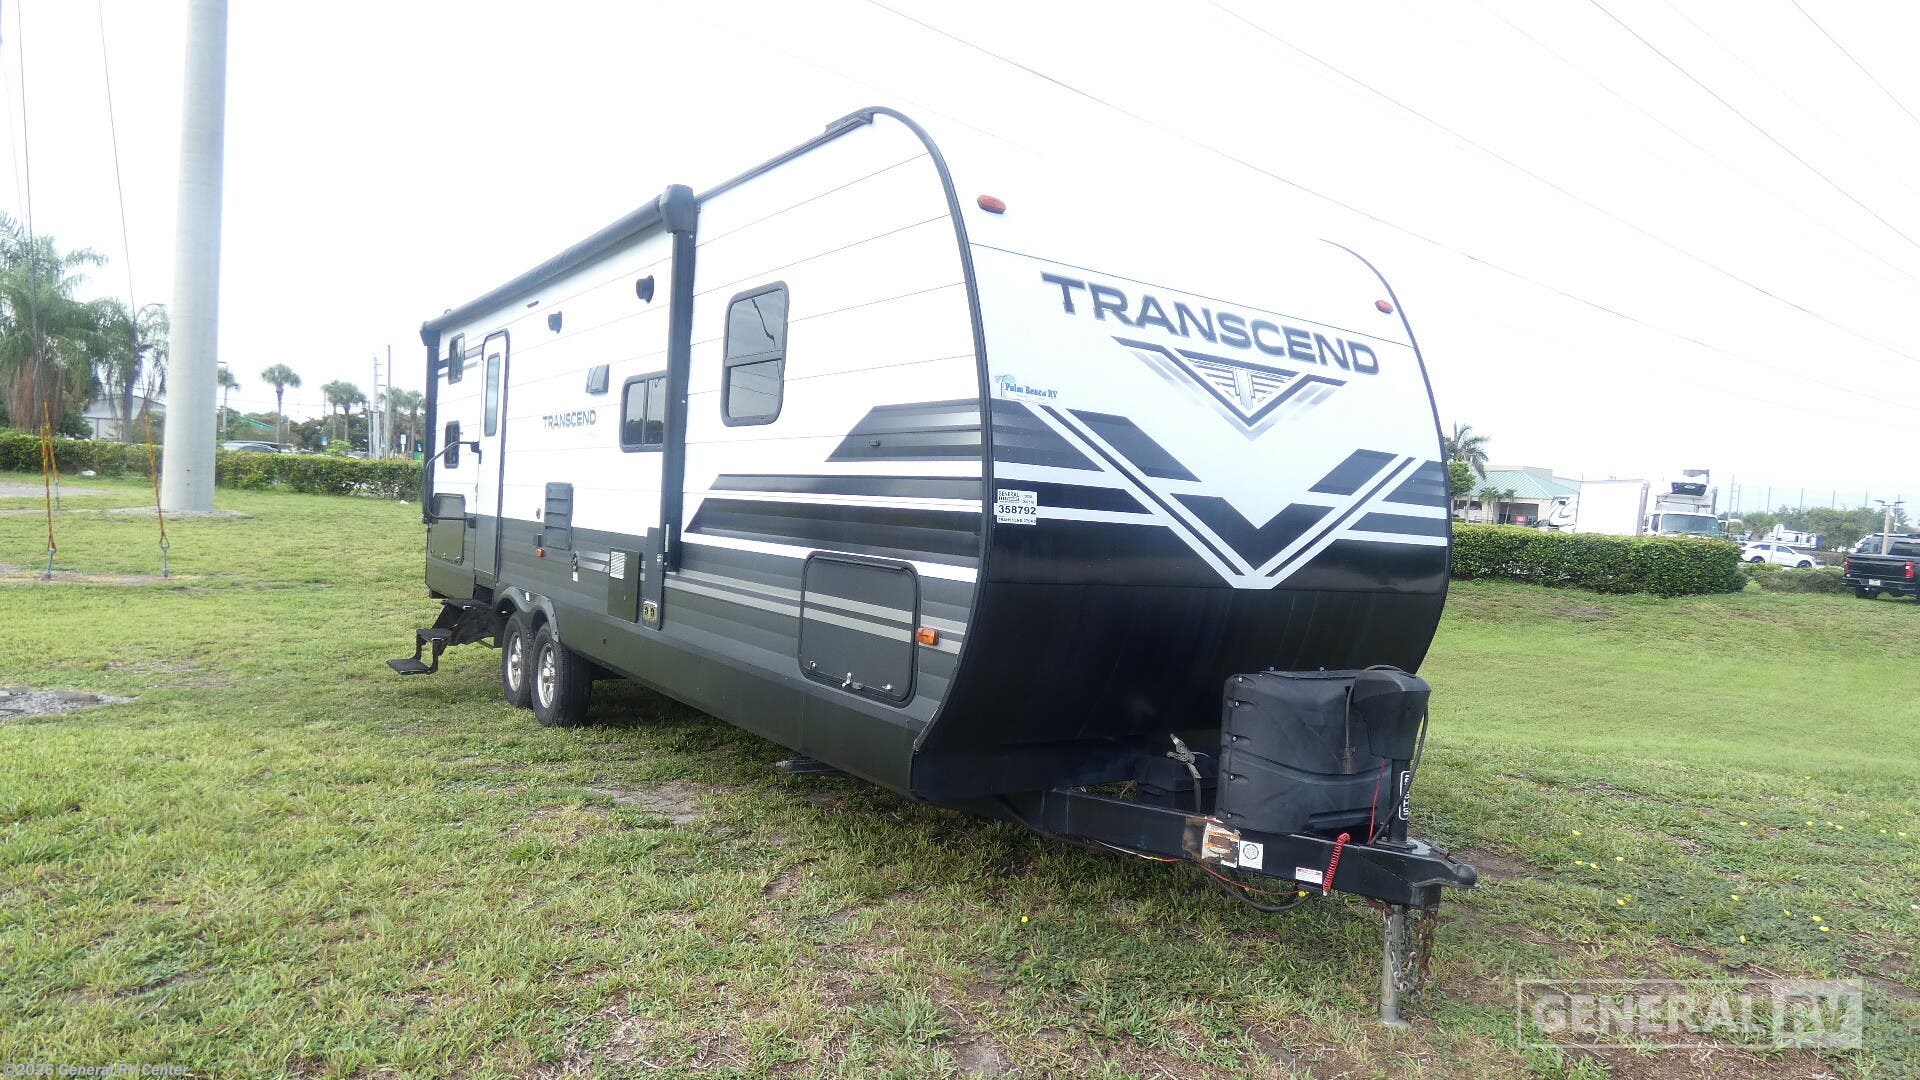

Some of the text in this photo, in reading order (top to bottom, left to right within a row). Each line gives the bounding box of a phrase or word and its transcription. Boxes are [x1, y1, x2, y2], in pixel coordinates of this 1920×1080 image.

[1040, 271, 1380, 375] TRANSCEND
[1005, 382, 1023, 393] Palm
[1048, 389, 1058, 399] RV
[542, 409, 597, 431] TRANSCEND
[998, 504, 1037, 515] 358792
